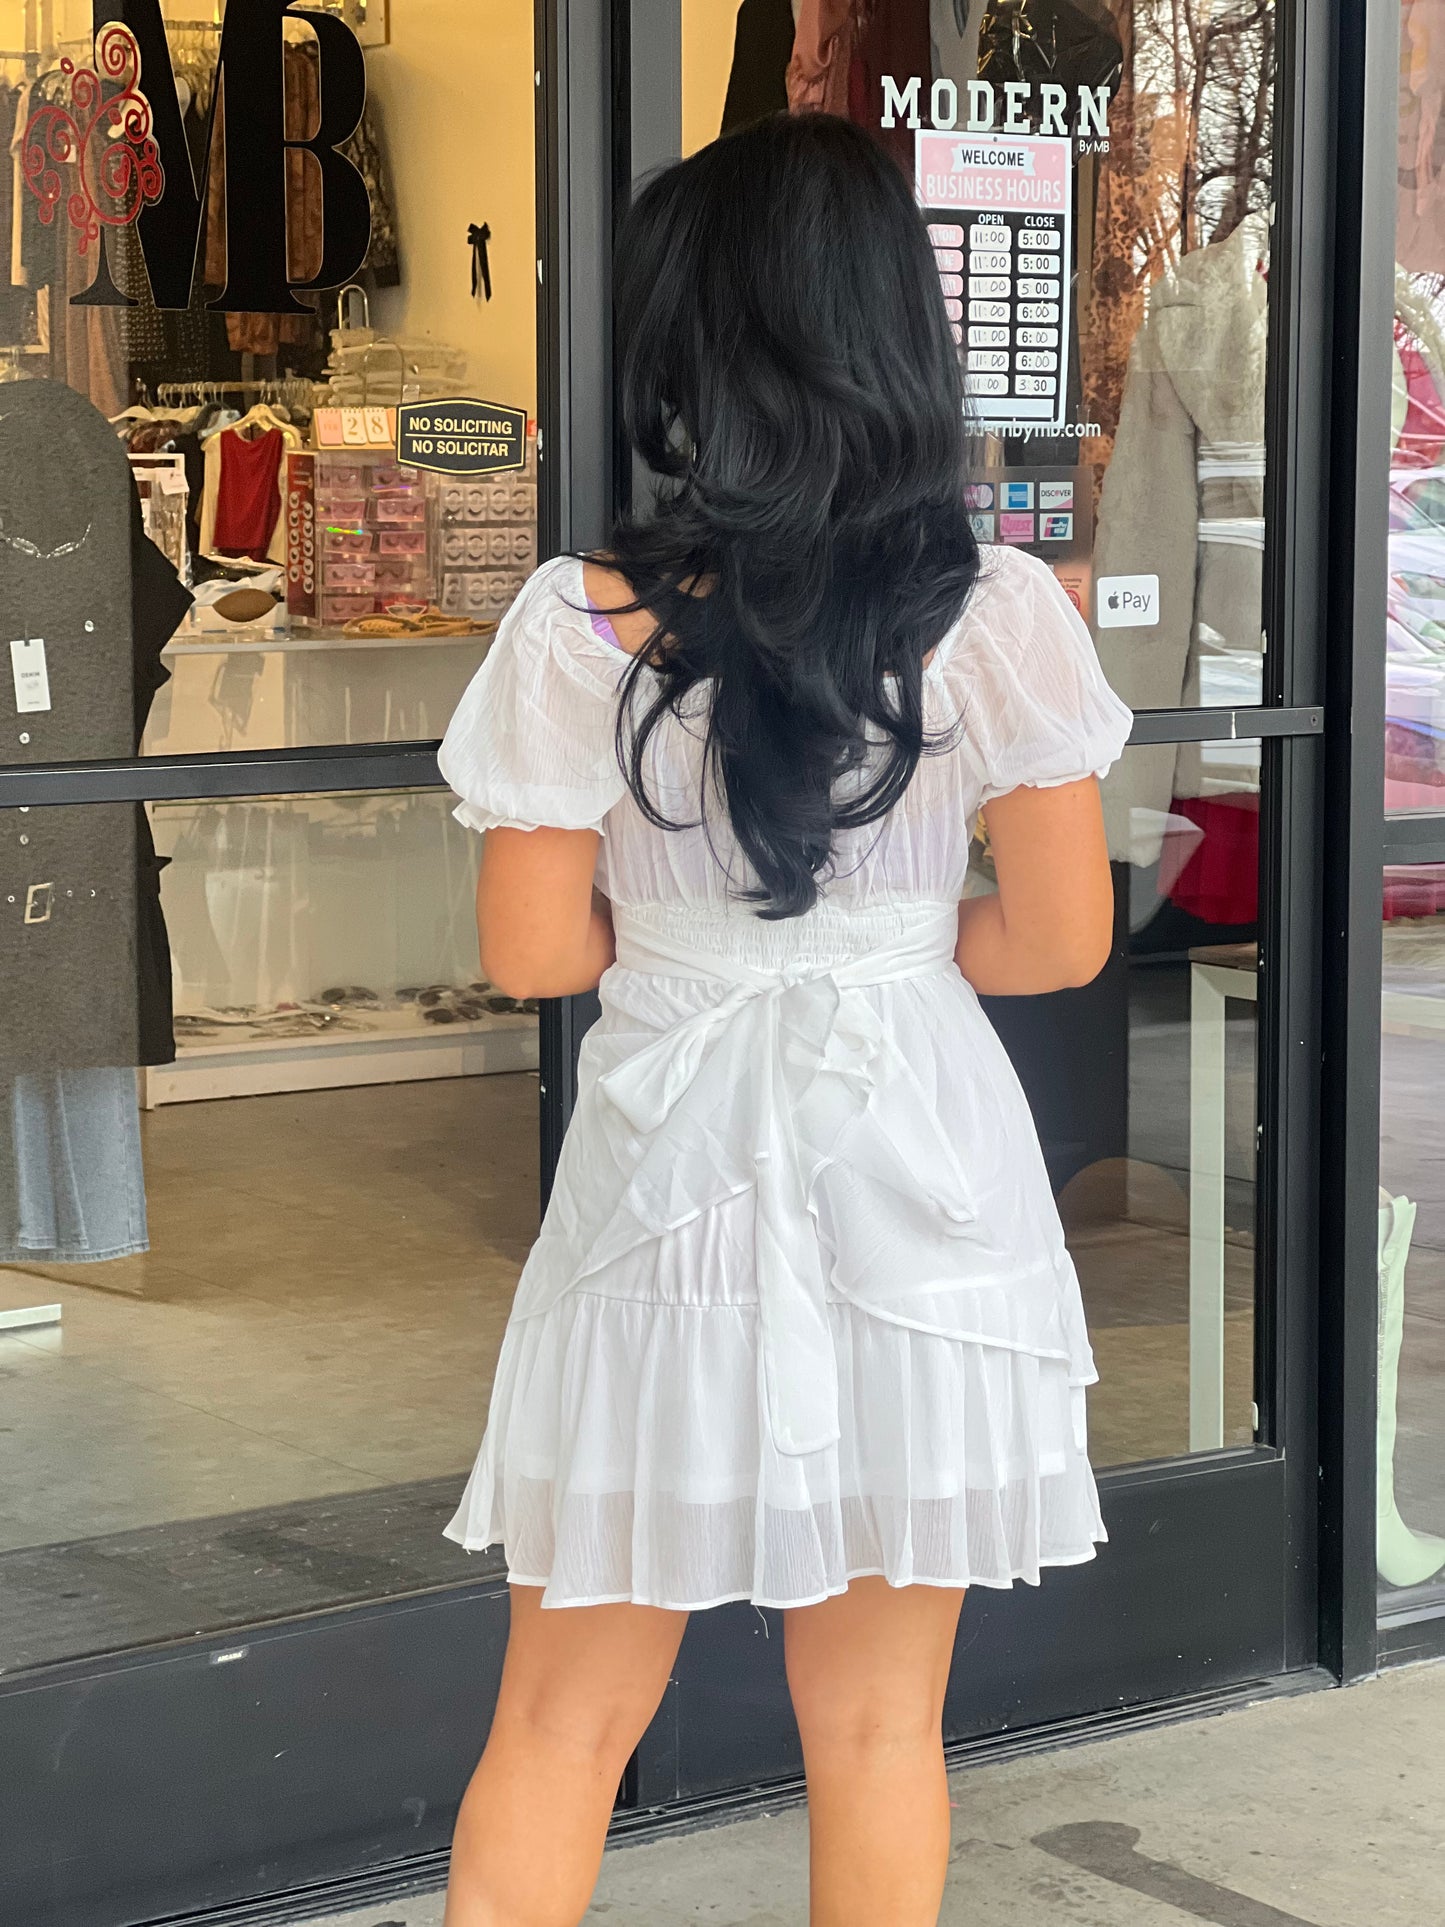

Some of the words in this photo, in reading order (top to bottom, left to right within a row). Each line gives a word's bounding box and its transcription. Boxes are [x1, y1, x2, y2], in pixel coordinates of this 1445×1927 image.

[881, 75, 1110, 137] MODERN
[1080, 139, 1092, 155] By
[1094, 140, 1110, 152] MB
[962, 149, 1025, 166] WELCOME
[927, 174, 1002, 201] BUSINESS
[1007, 178, 1061, 203] HOURS
[978, 213, 1004, 226] OPEN
[1024, 215, 1055, 228] CLOSE
[975, 231, 1006, 244] 11:00
[1022, 233, 1050, 246] 5:00
[974, 256, 1007, 269] 11:00
[1023, 257, 1050, 270] 5:00
[1022, 305, 1050, 319] 6:00
[1021, 330, 1049, 343] 6:00
[1021, 355, 1050, 368] 6:00
[409, 417, 431, 431] NO
[434, 418, 513, 435] SOLICITING
[412, 440, 433, 453] NO
[437, 441, 509, 456] SOLICITAR
[1041, 489, 1072, 498] DISCOVER
[1122, 592, 1151, 612] Pay
